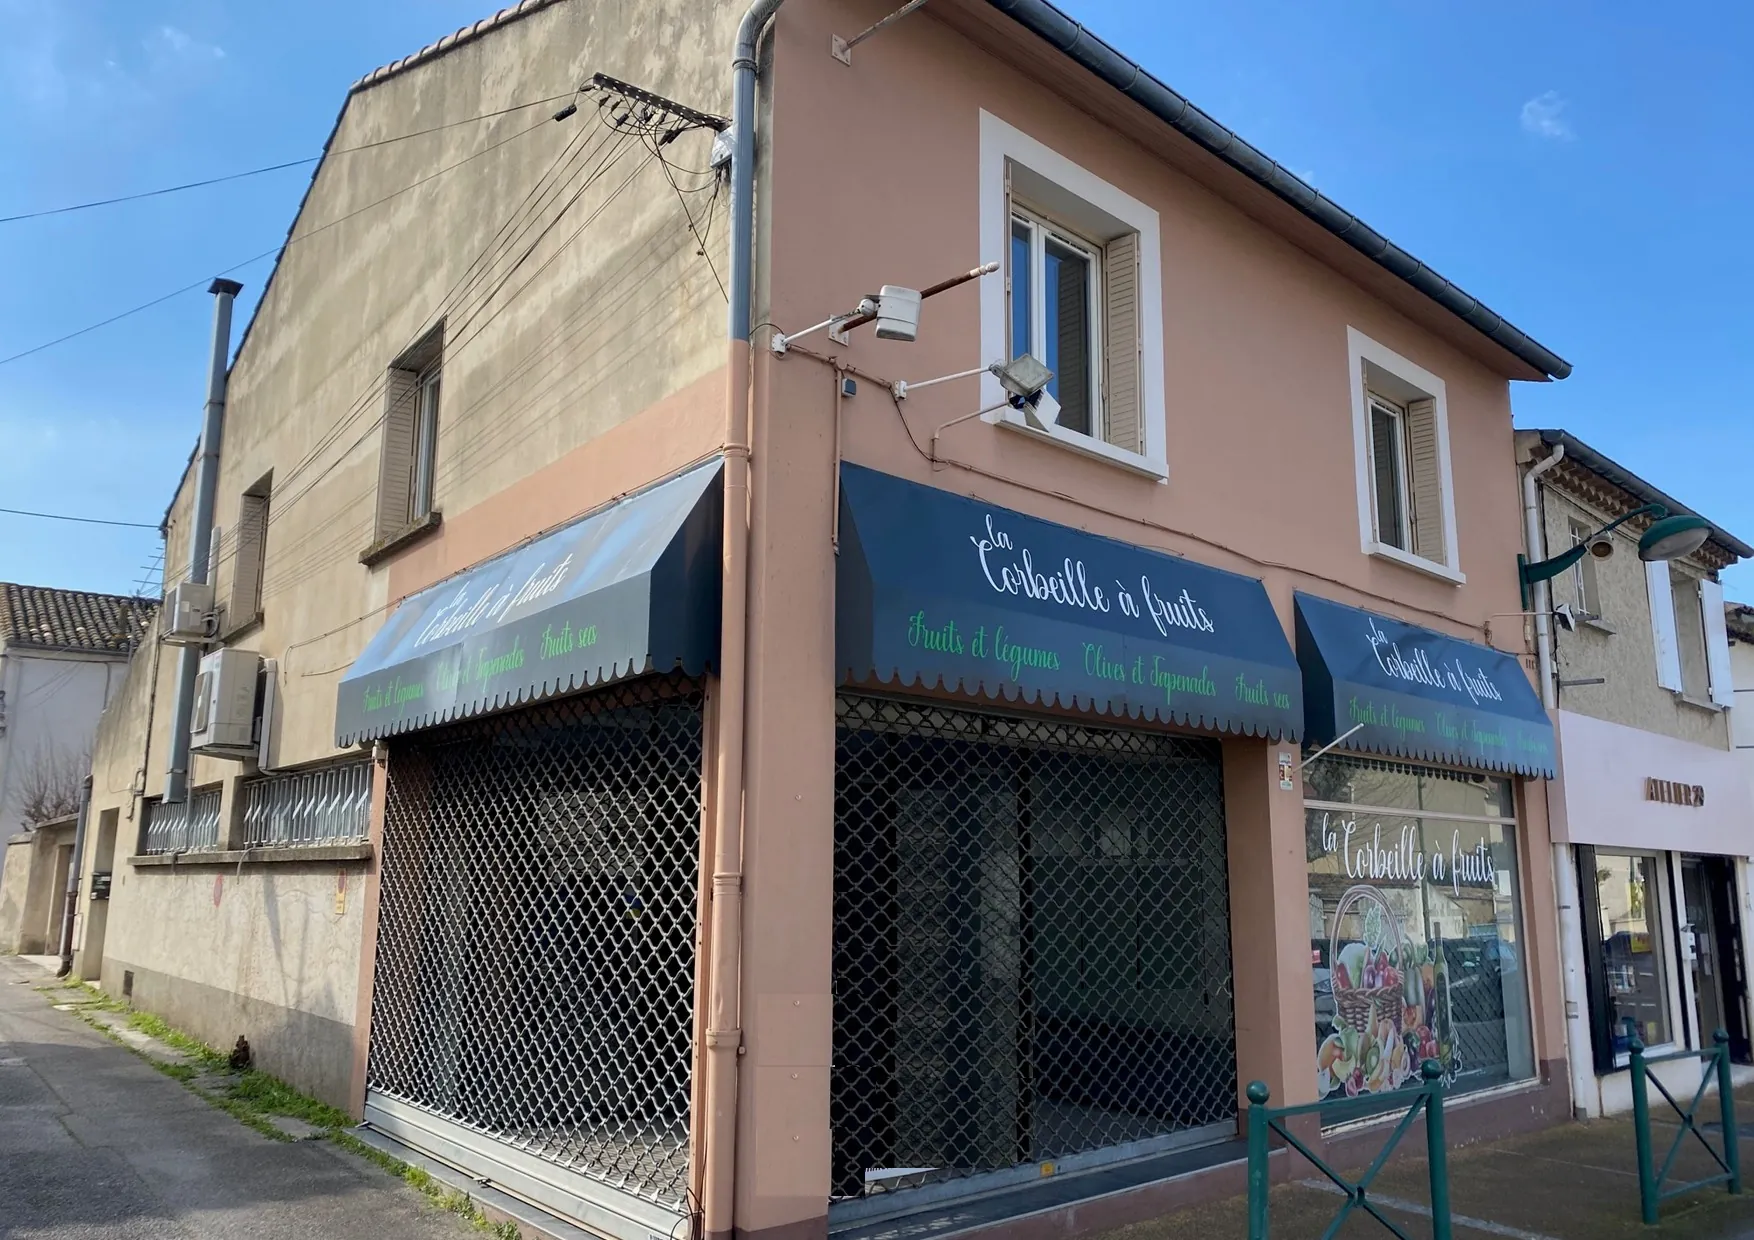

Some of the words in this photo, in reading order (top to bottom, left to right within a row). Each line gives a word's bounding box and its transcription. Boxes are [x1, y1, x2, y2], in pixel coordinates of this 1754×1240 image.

[986, 513, 1013, 550] la
[497, 553, 573, 624] fruits
[970, 535, 1110, 613] Corbeille
[1116, 579, 1140, 618] à
[1142, 575, 1215, 637] fruits
[540, 621, 574, 660] Fruits
[578, 623, 598, 649] secs
[908, 610, 965, 655] Fruits
[971, 625, 989, 658] et
[995, 625, 1061, 682] légumes
[1368, 616, 1388, 645] la
[1082, 641, 1126, 682] Olives
[1132, 655, 1146, 685] et
[1151, 655, 1217, 706] Tapenades
[1235, 672, 1269, 706] Fruits
[1366, 634, 1446, 689] Corbeille
[1444, 662, 1462, 692] à
[1455, 658, 1503, 706] fruits
[1322, 812, 1338, 852] la
[1342, 819, 1427, 881] Corbeille
[1433, 839, 1446, 881] à
[1452, 829, 1495, 897] fruits
